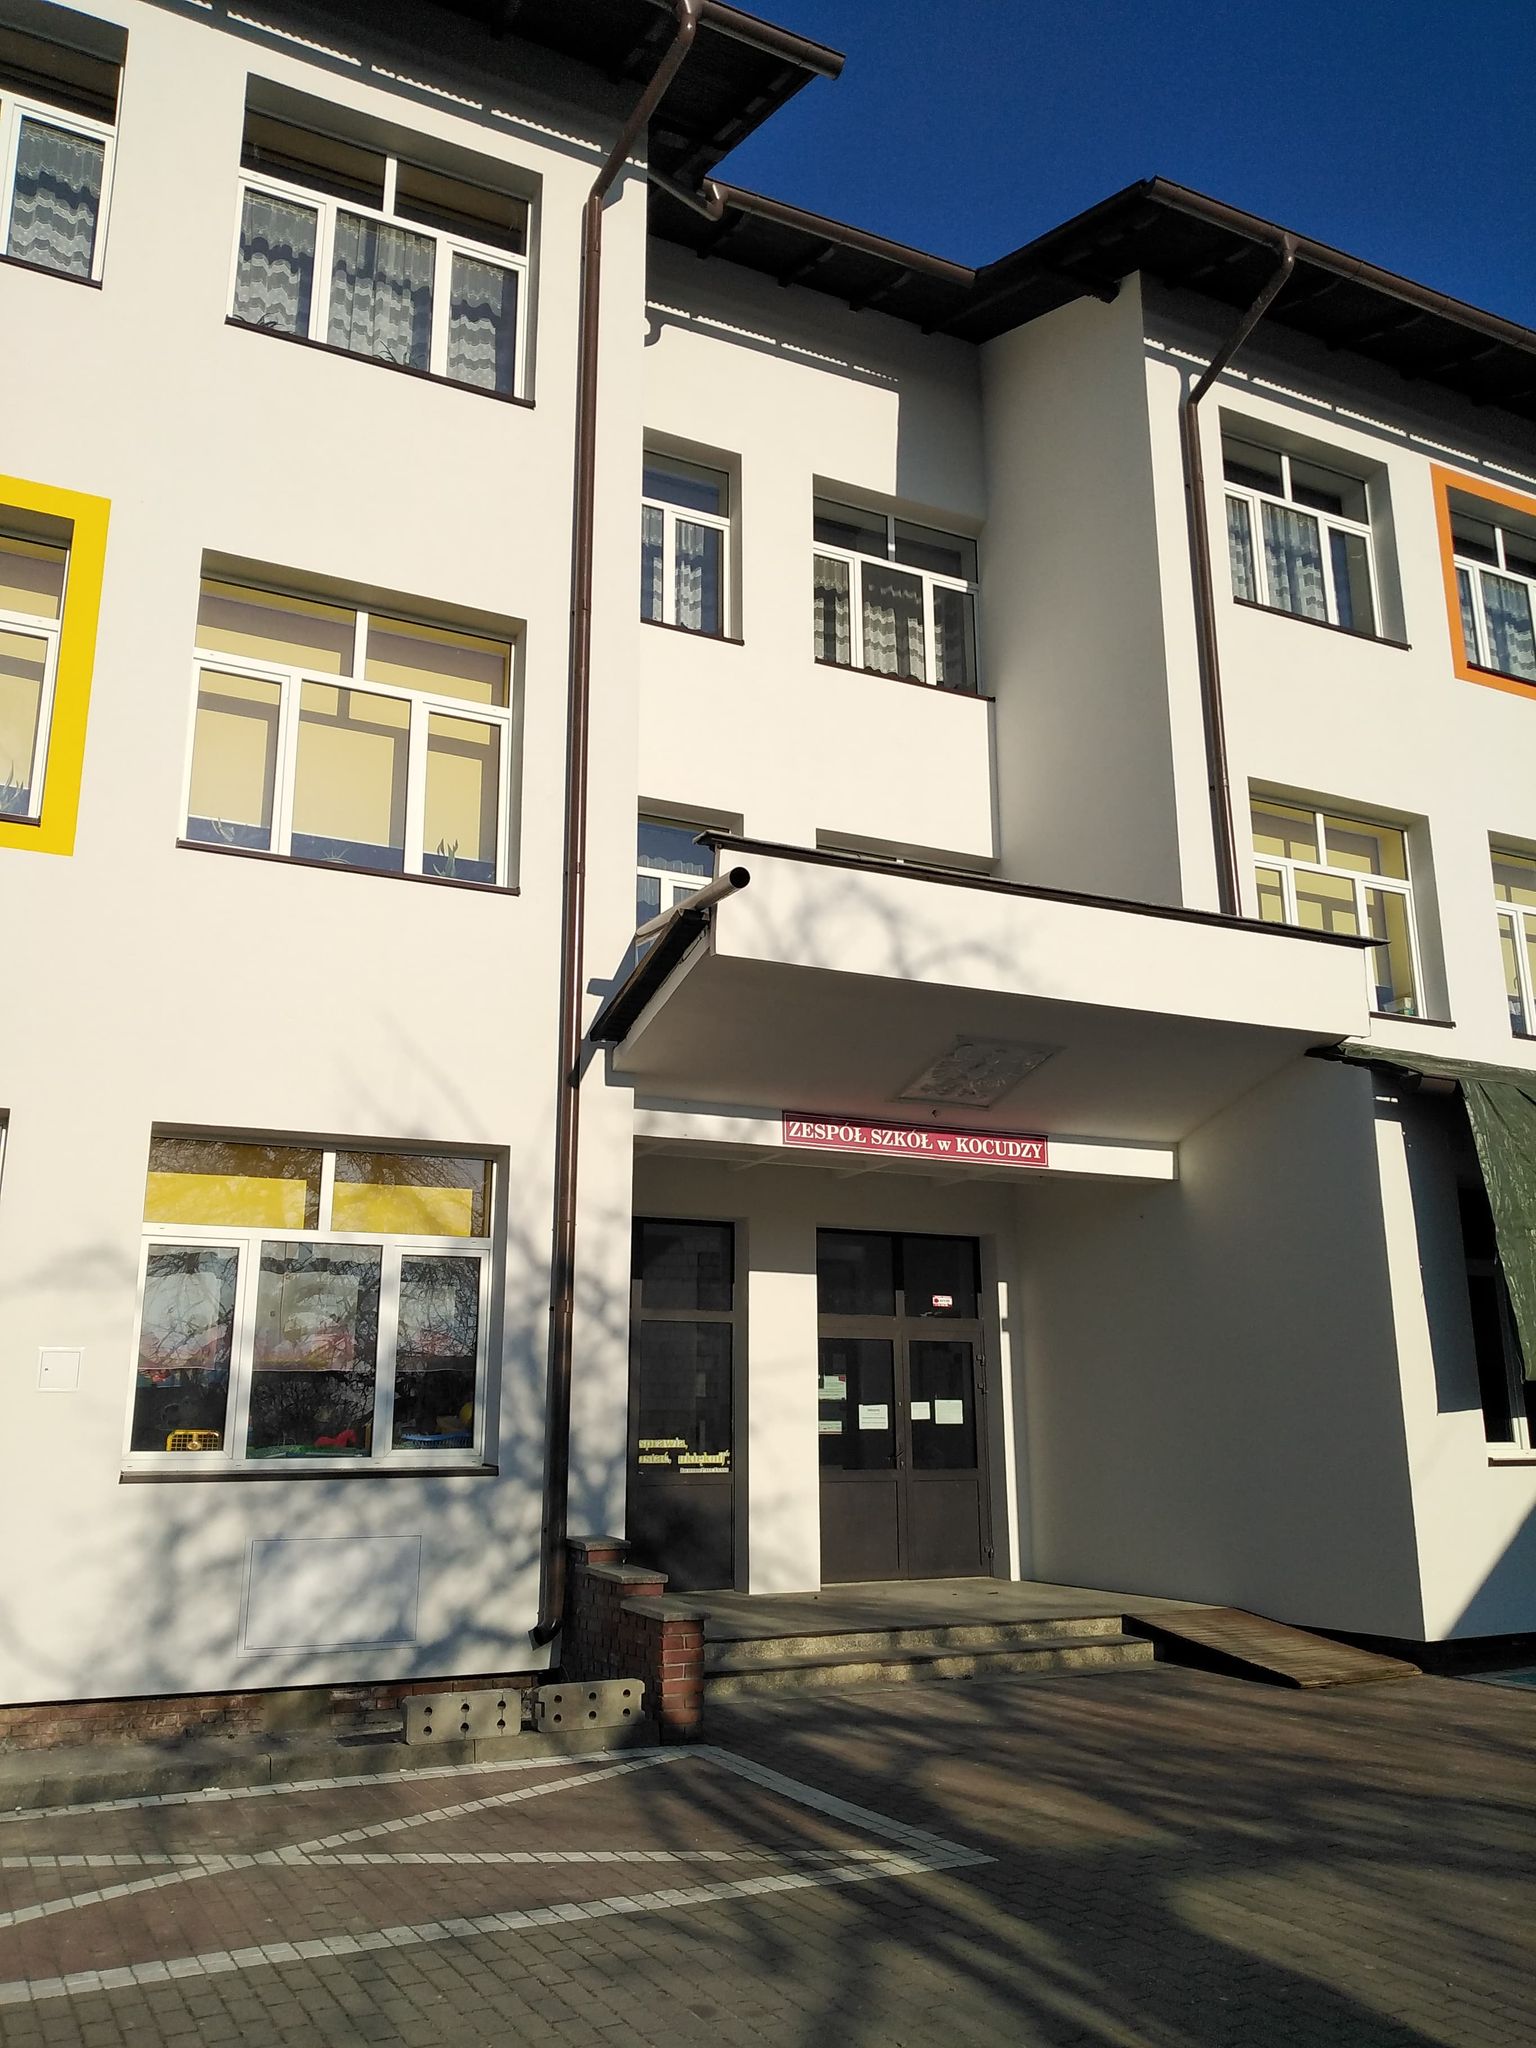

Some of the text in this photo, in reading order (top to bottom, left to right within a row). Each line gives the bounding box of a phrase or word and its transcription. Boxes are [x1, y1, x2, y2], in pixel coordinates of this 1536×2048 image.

[788, 1121, 1043, 1159] ZESPÓŁ SZKÓŁ w KOCUDZY
